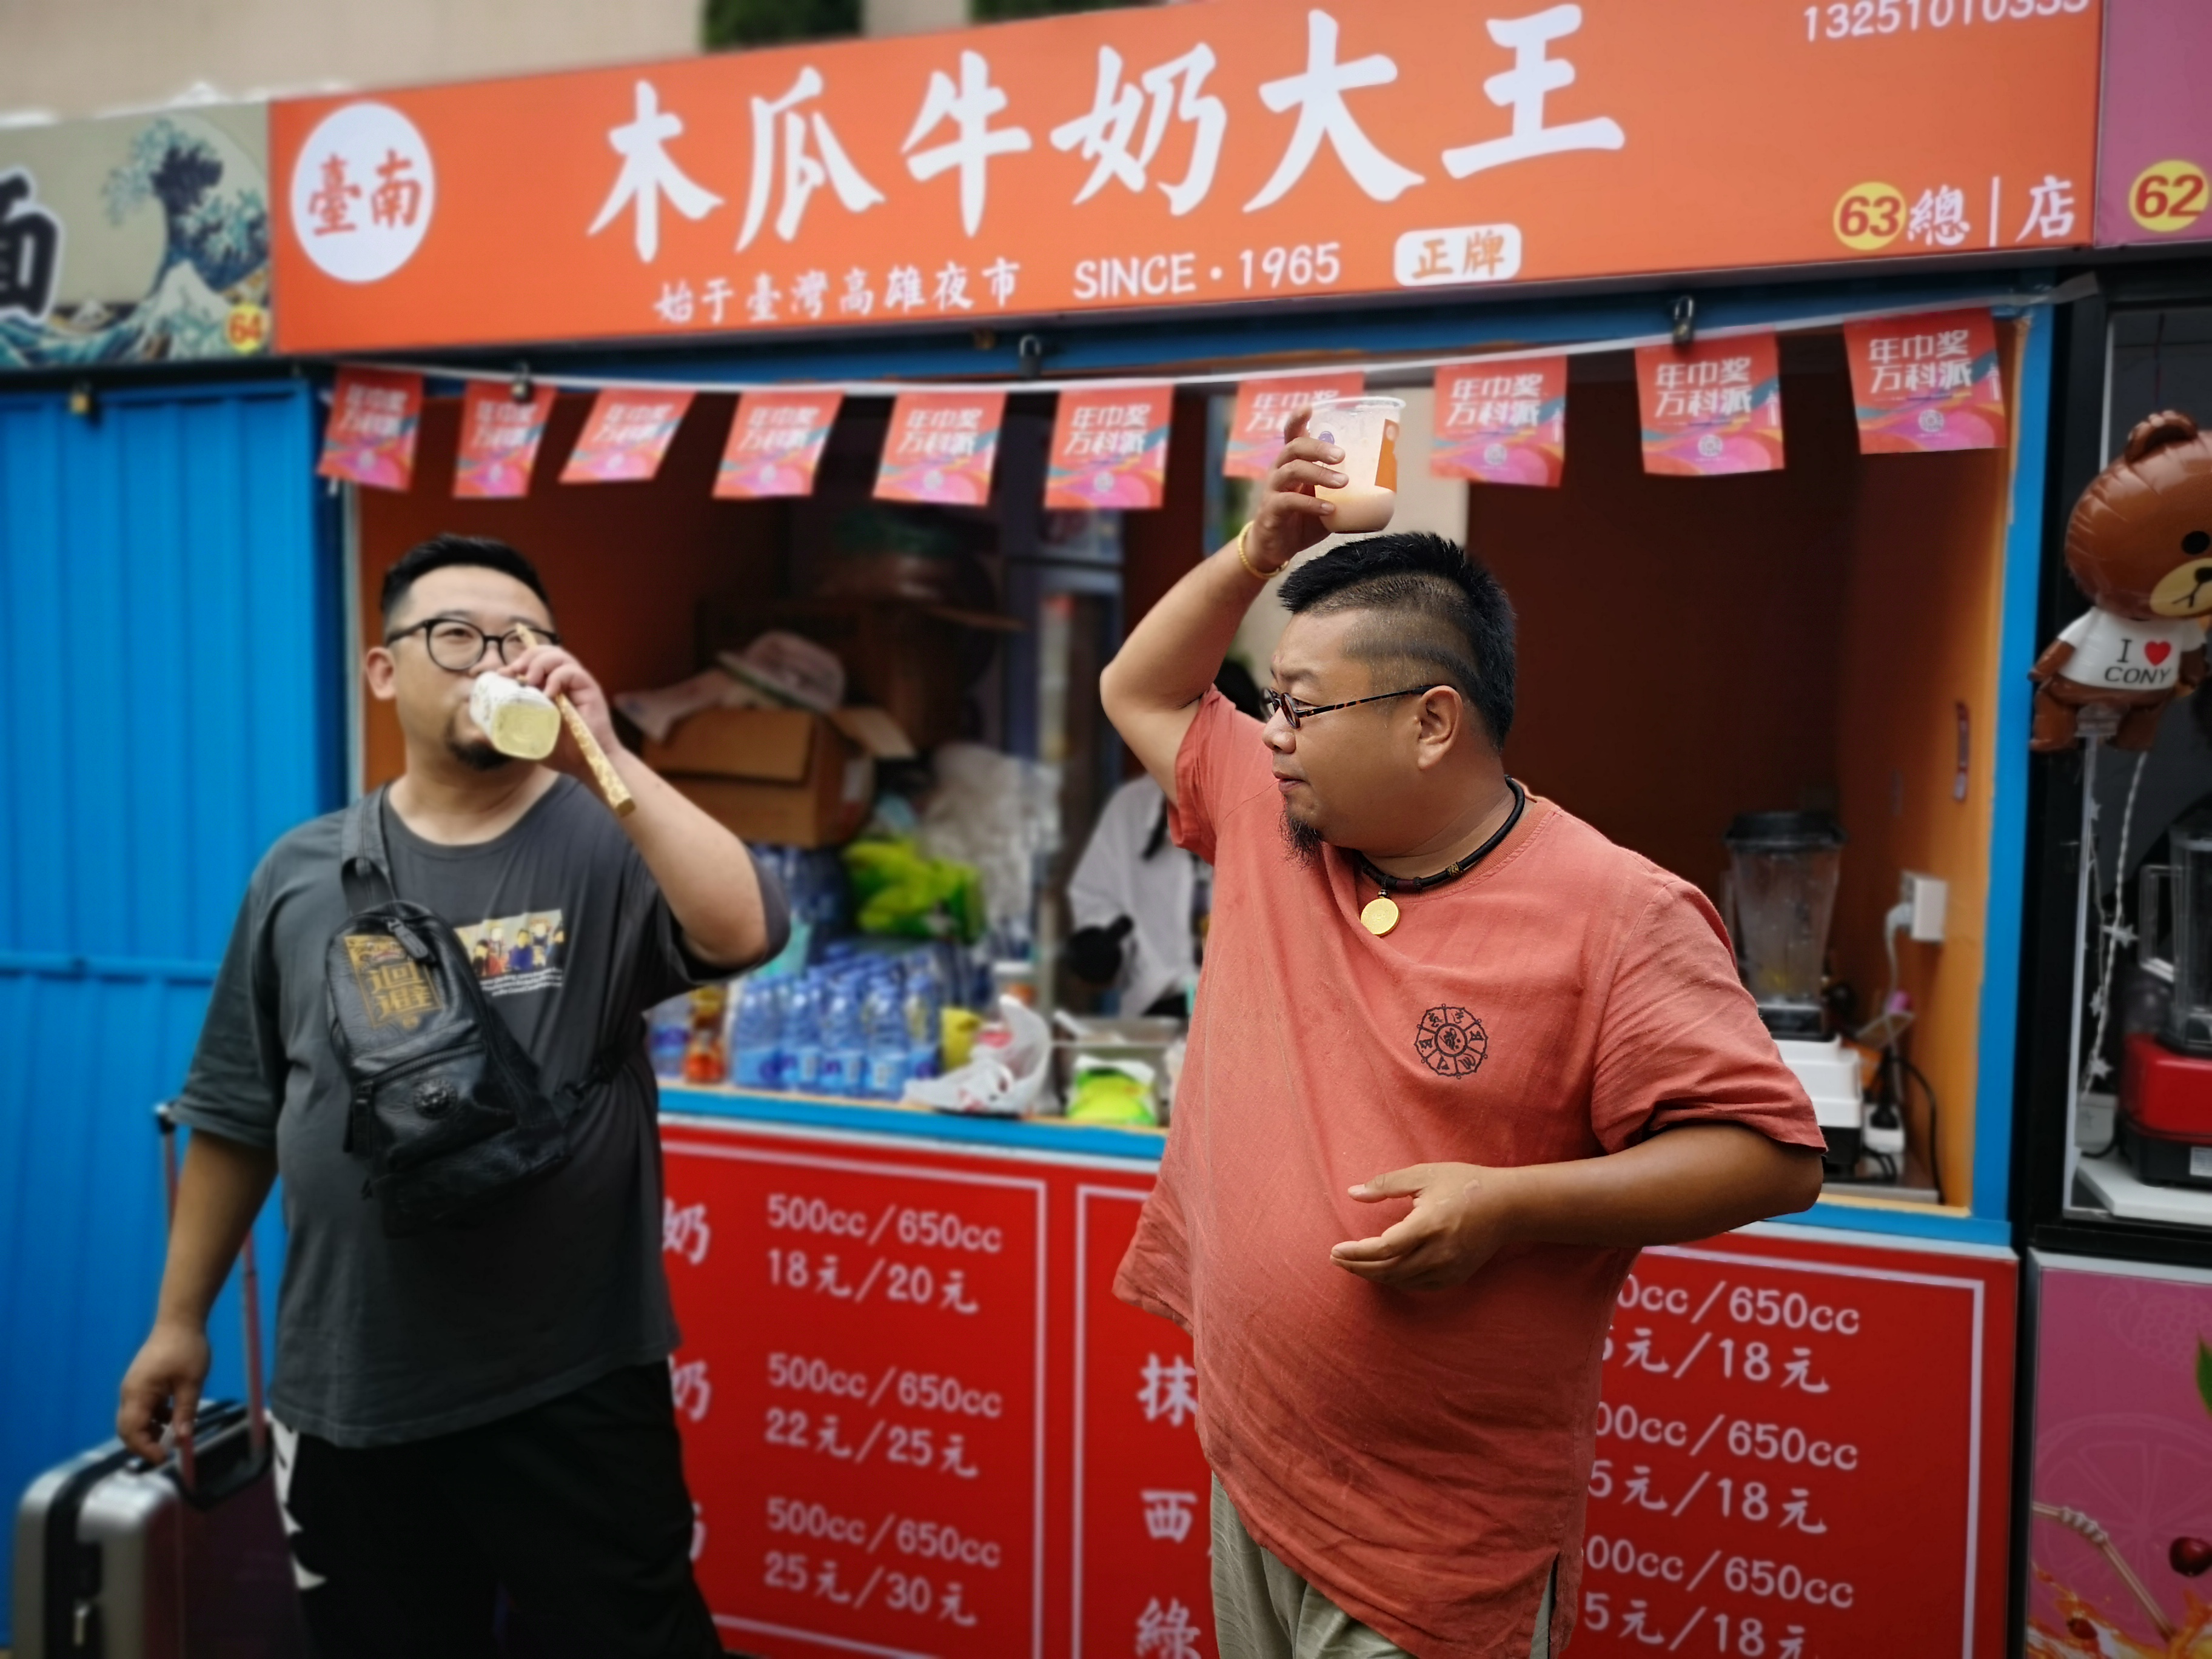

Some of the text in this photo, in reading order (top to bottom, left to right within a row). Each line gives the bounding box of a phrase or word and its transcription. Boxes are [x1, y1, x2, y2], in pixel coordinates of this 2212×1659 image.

[587, 4, 1626, 263] 木瓜牛奶大王
[308, 150, 421, 236] 臺南
[1838, 196, 1902, 237] 63
[2136, 175, 2205, 218] 62
[1073, 253, 1196, 300] SINCE
[1239, 243, 1341, 289] 1965
[1412, 230, 1505, 279] 正牌
[654, 257, 1021, 323] 始于臺灣高雄夜市
[2104, 666, 2172, 684] CONY
[2117, 639, 2132, 663] I
[767, 1193, 1002, 1254] 500cc/650cc
[767, 1352, 1003, 1419] 500cc/650cc
[766, 1496, 1002, 1568] 500cc/650cc
[1140, 1489, 1198, 1543] 西
